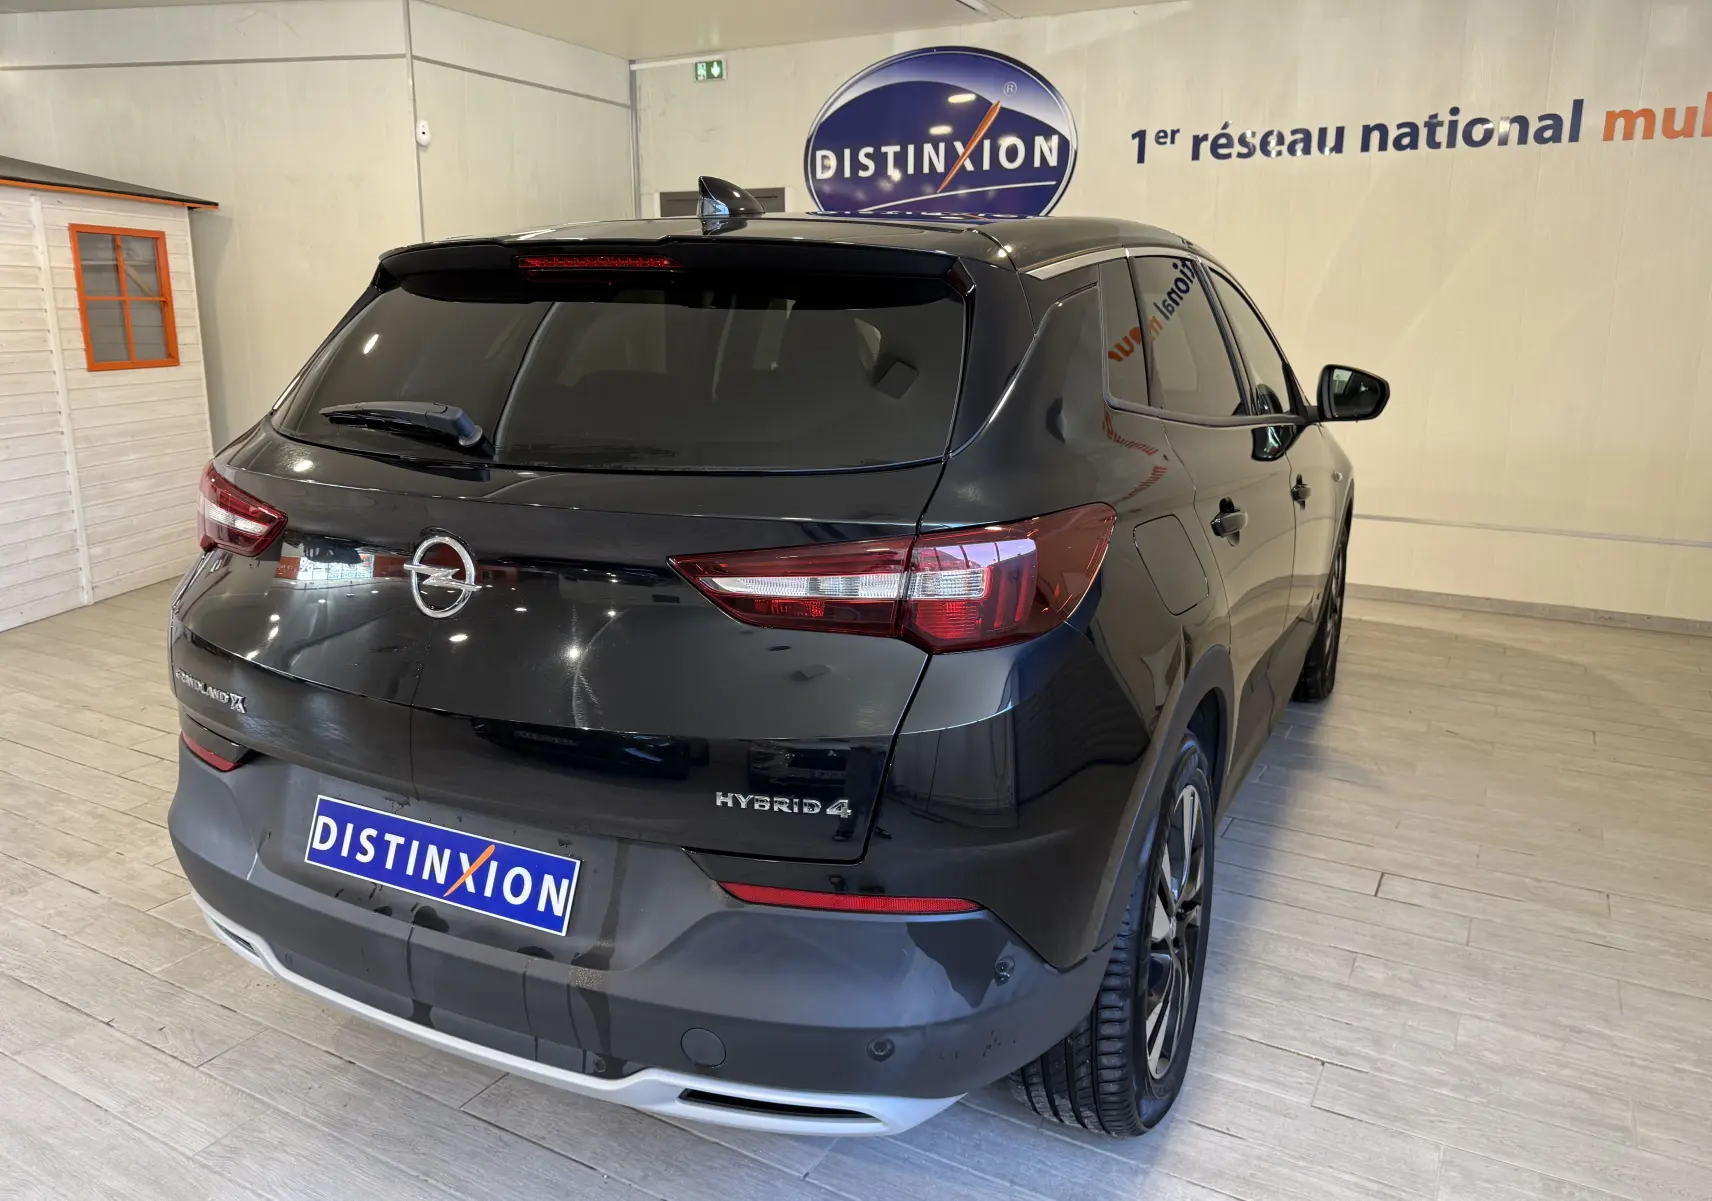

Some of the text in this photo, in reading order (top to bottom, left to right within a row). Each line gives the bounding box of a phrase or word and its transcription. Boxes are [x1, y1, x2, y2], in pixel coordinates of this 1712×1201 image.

[815, 101, 1058, 193] DISTINXION
[1131, 128, 1180, 164] 1er
[1191, 120, 1346, 161] réseau
[1360, 98, 1584, 153] national
[311, 815, 570, 917] DISTINXION
